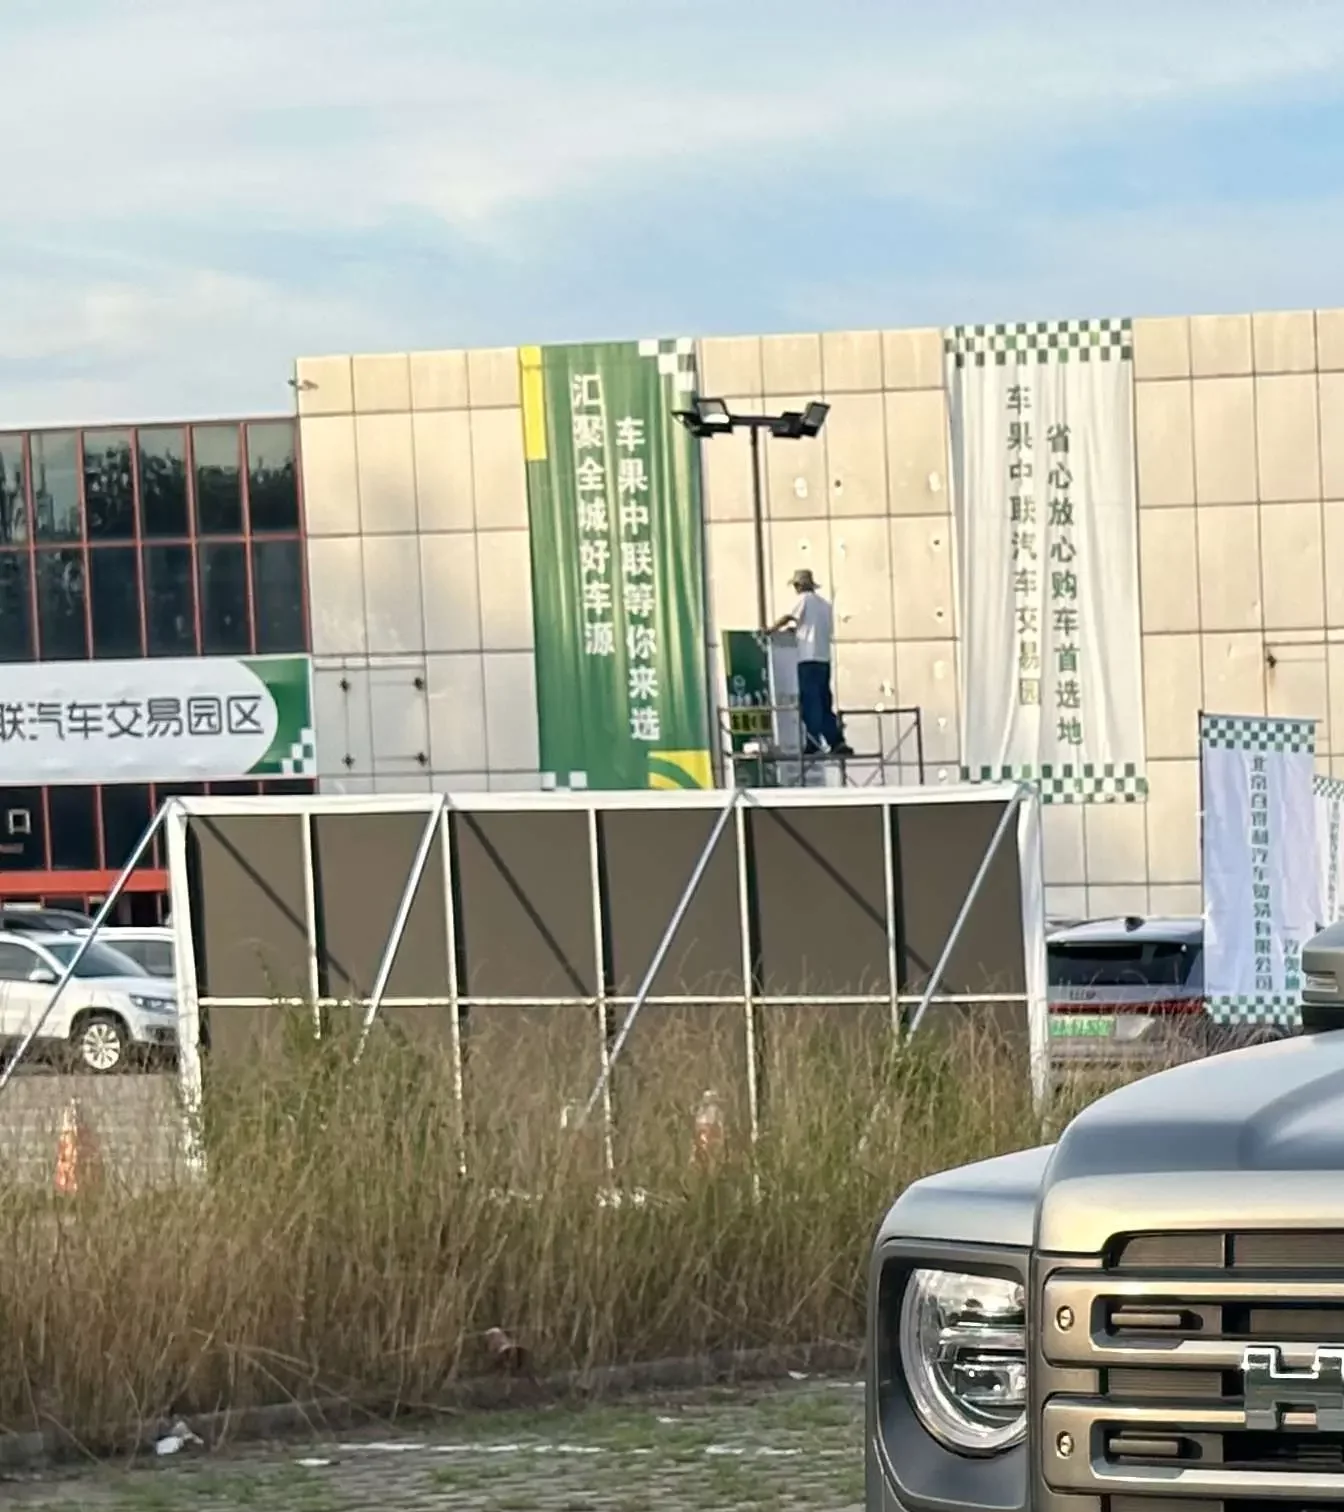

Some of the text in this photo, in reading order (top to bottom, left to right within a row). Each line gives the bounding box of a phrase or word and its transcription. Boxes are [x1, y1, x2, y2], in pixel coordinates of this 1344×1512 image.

[573, 373, 615, 657] 汇聚全城好车源
[615, 416, 661, 742] 车果中联等你来选
[1046, 423, 1084, 746] 省心放心购车首选地
[0, 695, 264, 742] 联汽车交易园区
